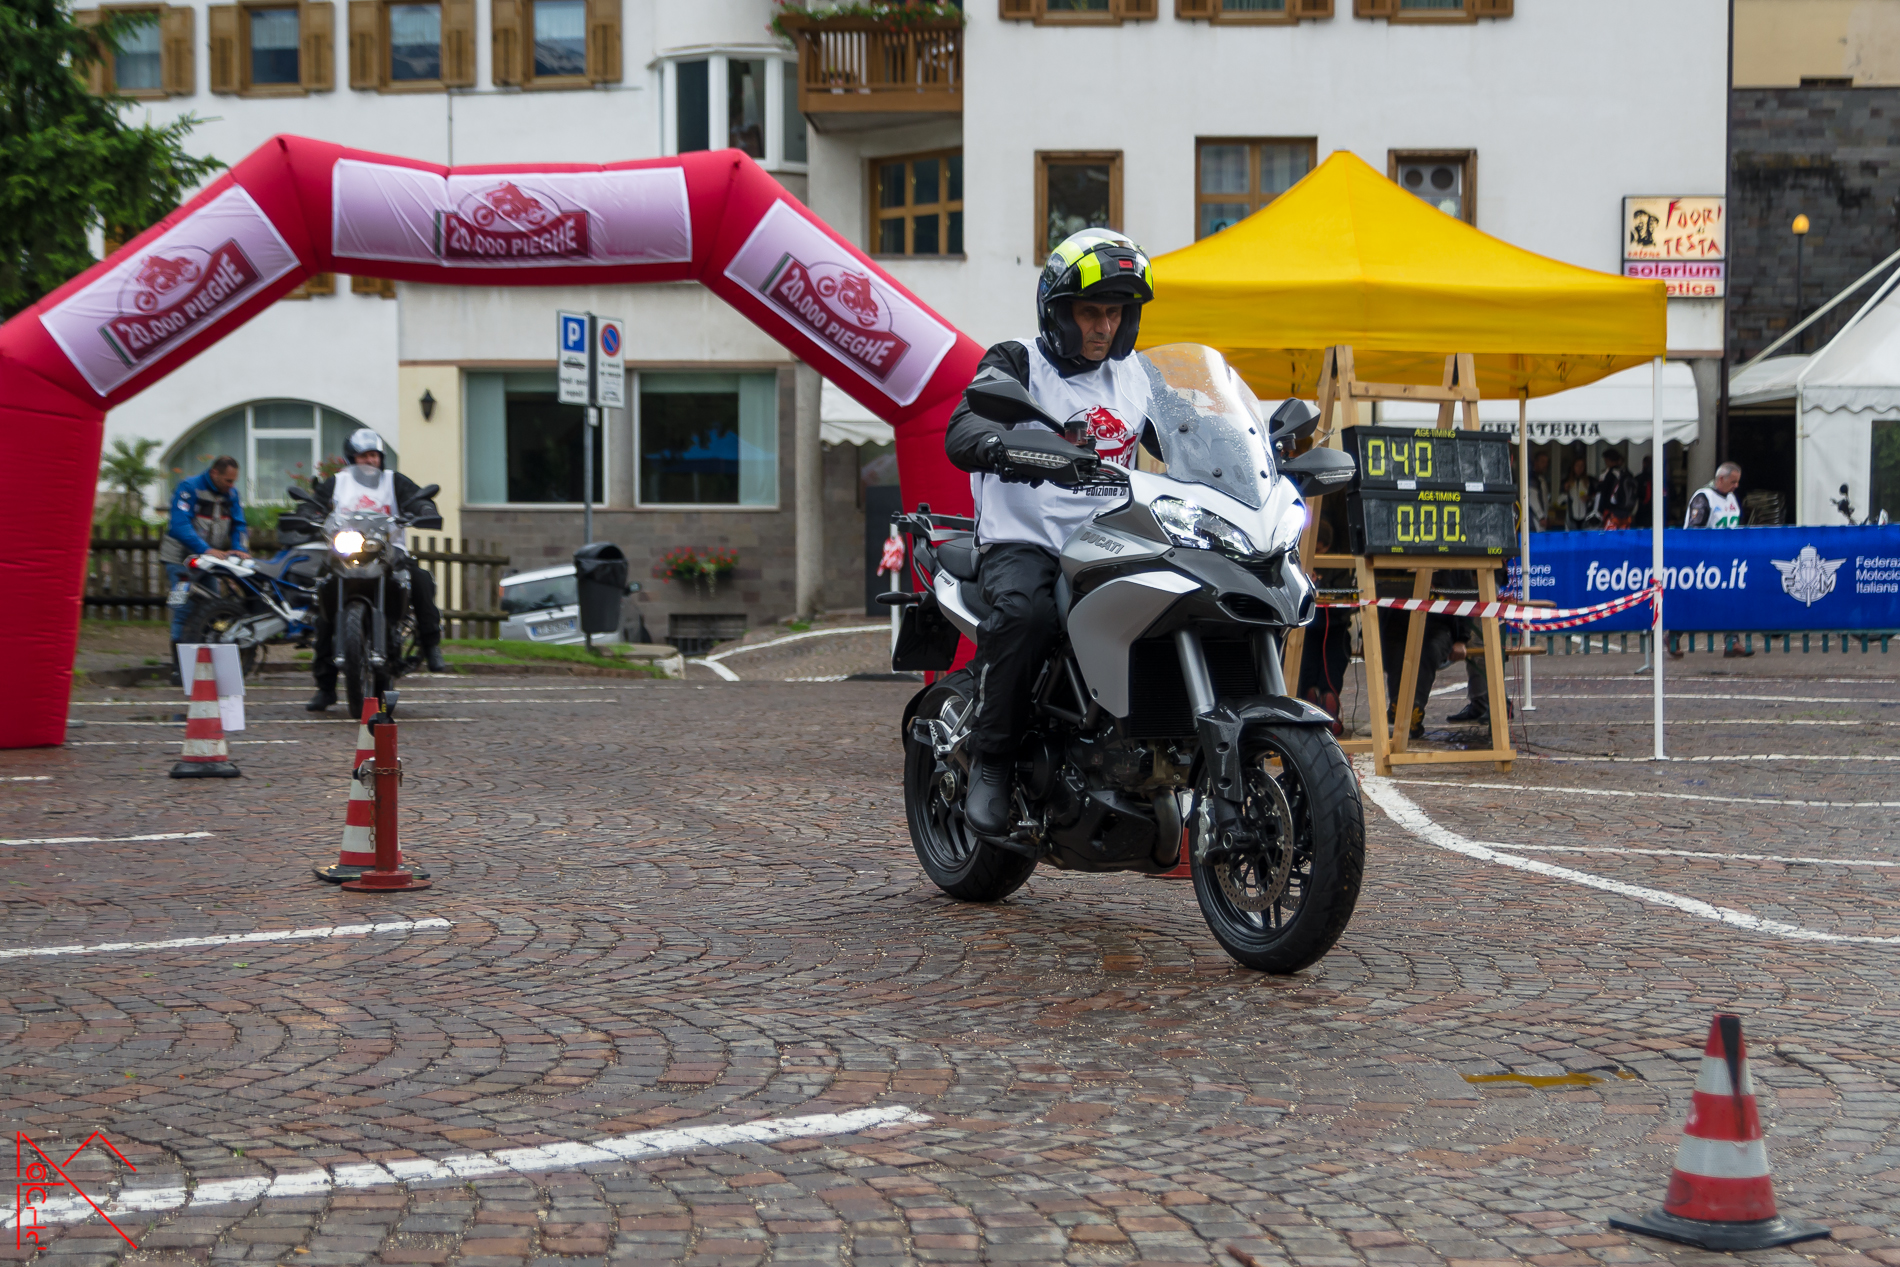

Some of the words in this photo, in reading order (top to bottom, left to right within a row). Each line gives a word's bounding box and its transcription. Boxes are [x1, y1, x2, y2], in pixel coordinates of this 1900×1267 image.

[450, 217, 507, 255] 20.000
[511, 218, 577, 255] PIEGHE
[1664, 234, 1722, 257] TESTA
[1628, 262, 1721, 277] solarium
[116, 311, 188, 349] 20.000
[183, 252, 246, 319] PIEGHE
[1667, 281, 1716, 296] etica
[780, 268, 828, 328] 20.000
[825, 321, 896, 367] PIEGHE
[567, 321, 581, 348] P
[1368, 439, 1432, 477] 040
[1085, 485, 1118, 497] edizione
[1080, 531, 1125, 555] DUCATI
[1586, 558, 1748, 591] federmoto.it
[1856, 581, 1898, 593] Italiana
